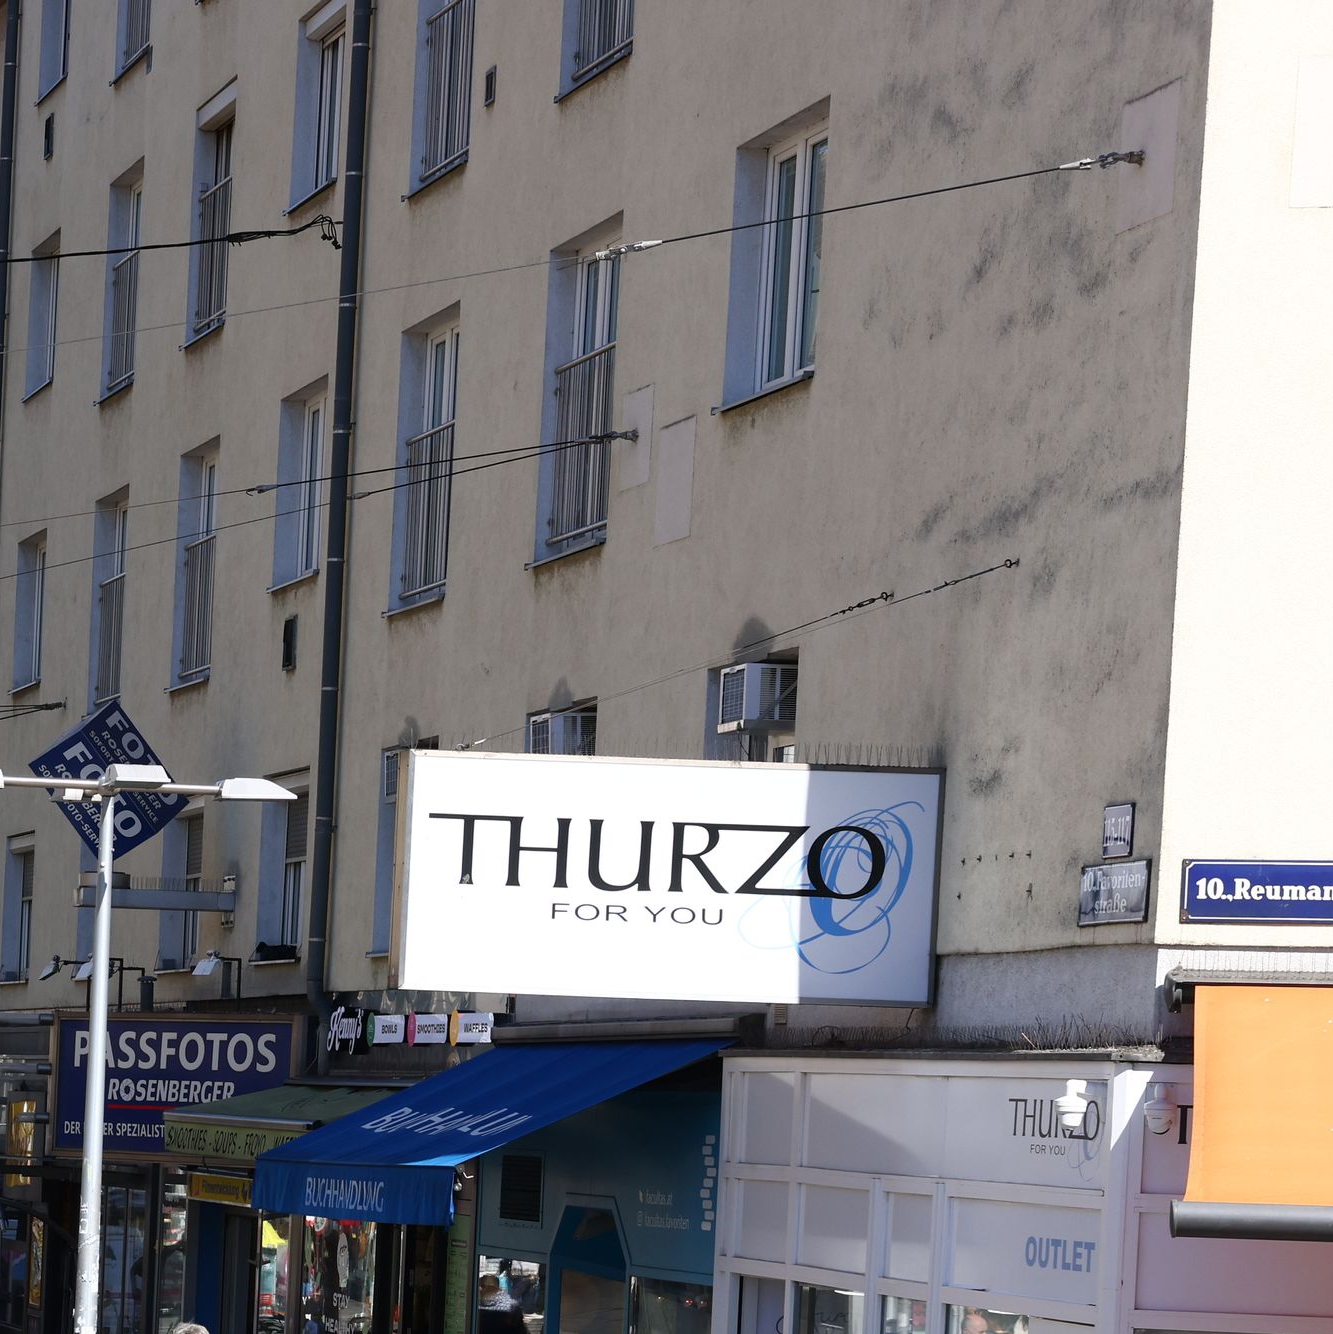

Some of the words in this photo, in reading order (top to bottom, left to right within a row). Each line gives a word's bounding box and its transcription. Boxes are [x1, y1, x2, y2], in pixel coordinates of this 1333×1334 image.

[106, 710, 178, 806] FOO
[429, 813, 886, 899] THURZO
[551, 902, 628, 923] FOR
[644, 906, 724, 926] YOU
[1094, 893, 1127, 915] straße
[381, 1024, 398, 1034] BOWLS
[417, 1023, 446, 1034] SMOOTHIES
[463, 1023, 488, 1033] WAFFLES
[108, 1078, 236, 1104] ROSENBERGER
[64, 1120, 81, 1135] DER
[116, 1123, 165, 1138] SPEZIALIST
[1030, 1143, 1047, 1154] FOR
[1048, 1145, 1066, 1156] YOU
[1025, 1236, 1096, 1273] OUTLET
[332, 1292, 351, 1309] STAY
